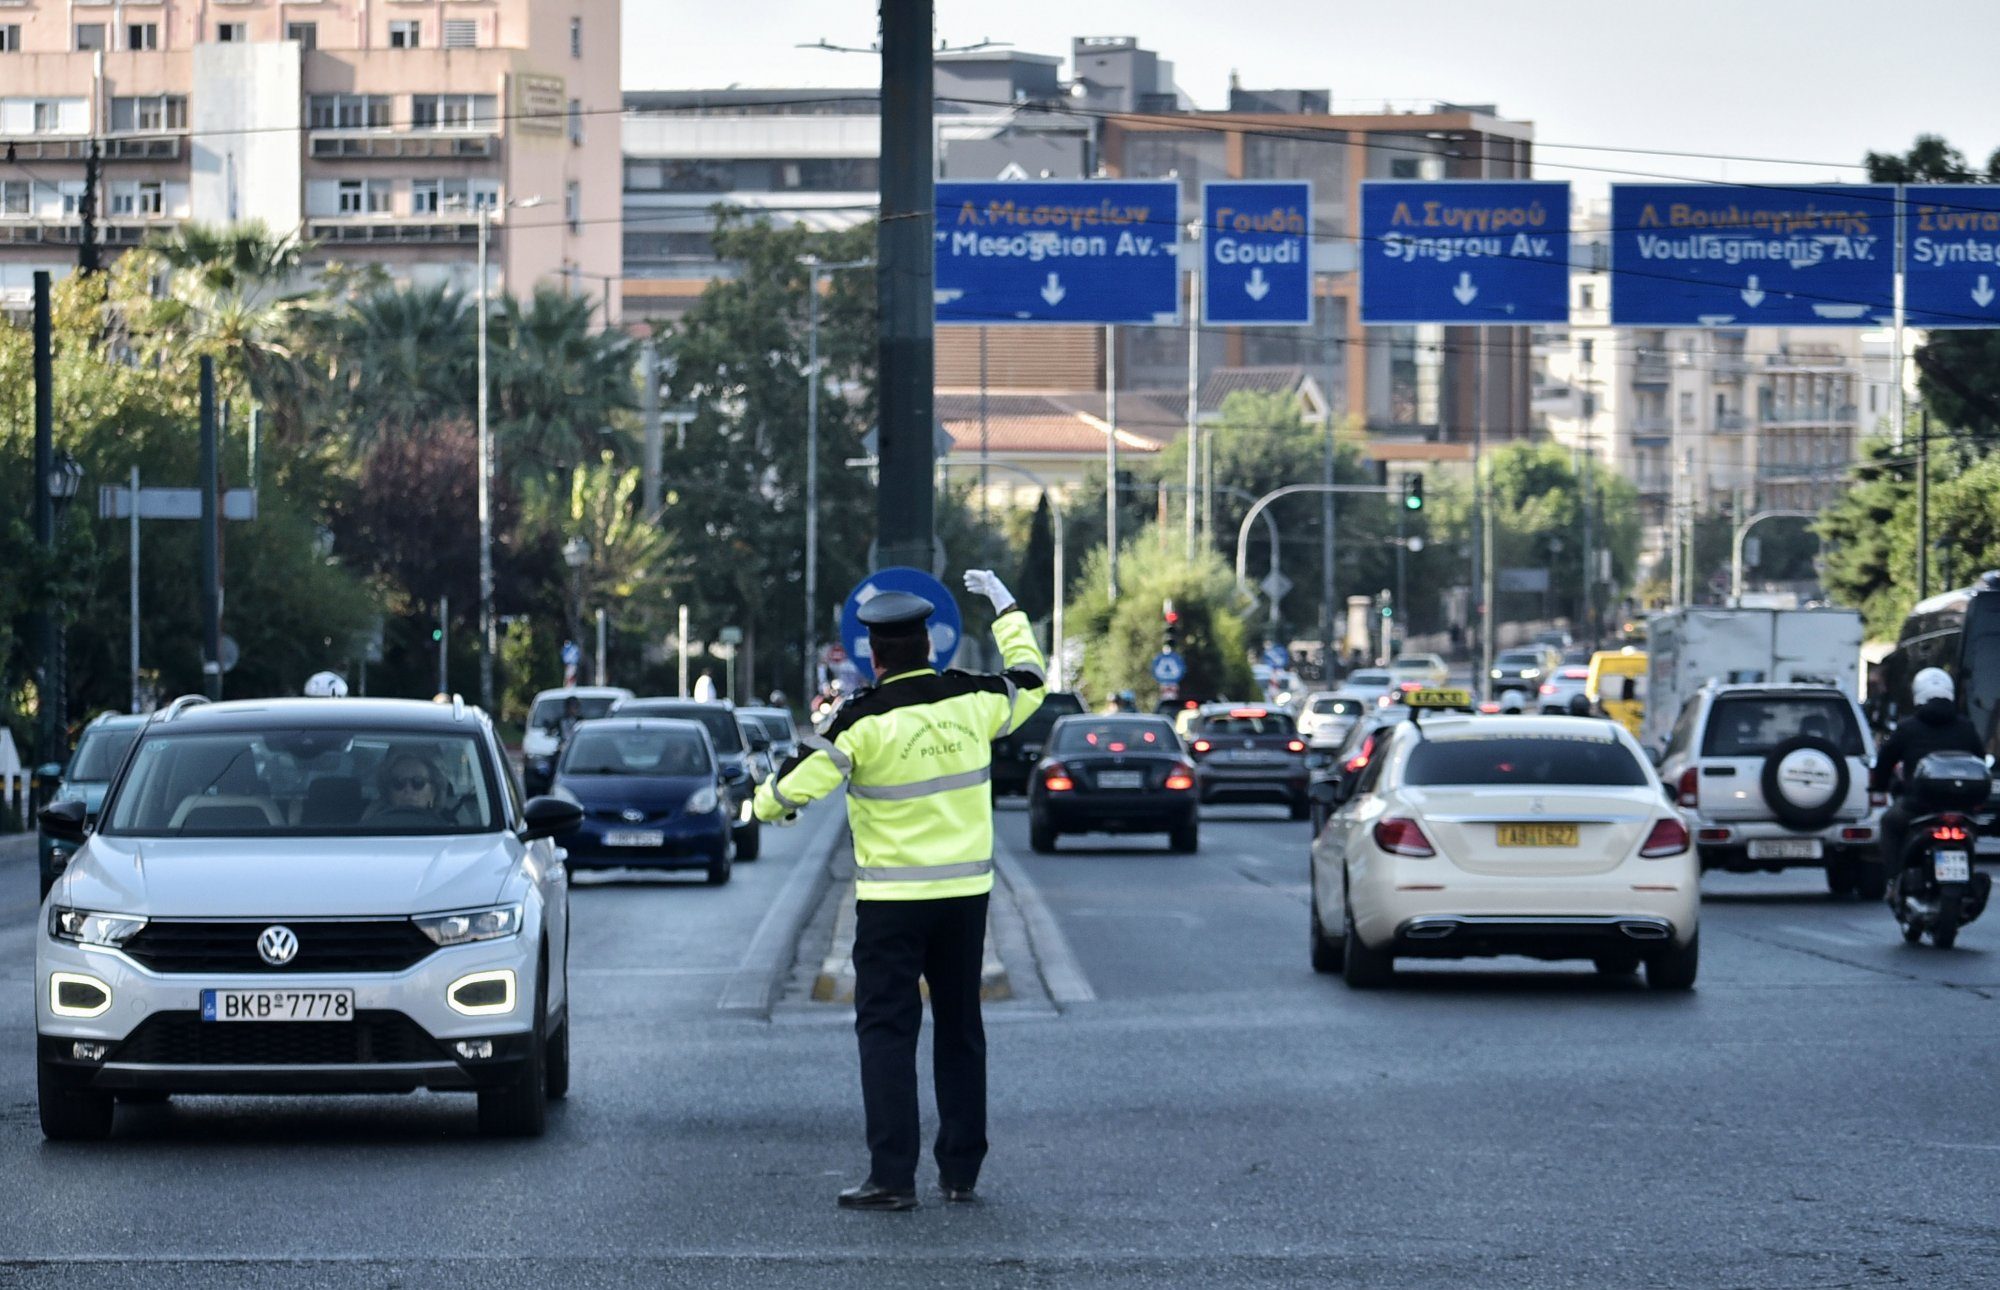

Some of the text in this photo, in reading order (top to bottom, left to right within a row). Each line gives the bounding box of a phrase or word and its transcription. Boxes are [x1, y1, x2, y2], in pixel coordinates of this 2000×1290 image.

[952, 231, 1158, 261] Mesogeion Av.
[1214, 238, 1300, 264] Goudi
[1383, 232, 1554, 262] Syngrou Av.
[1833, 236, 1876, 260] Av.
[1415, 692, 1463, 705] TAXI
[920, 741, 963, 757] POLICE
